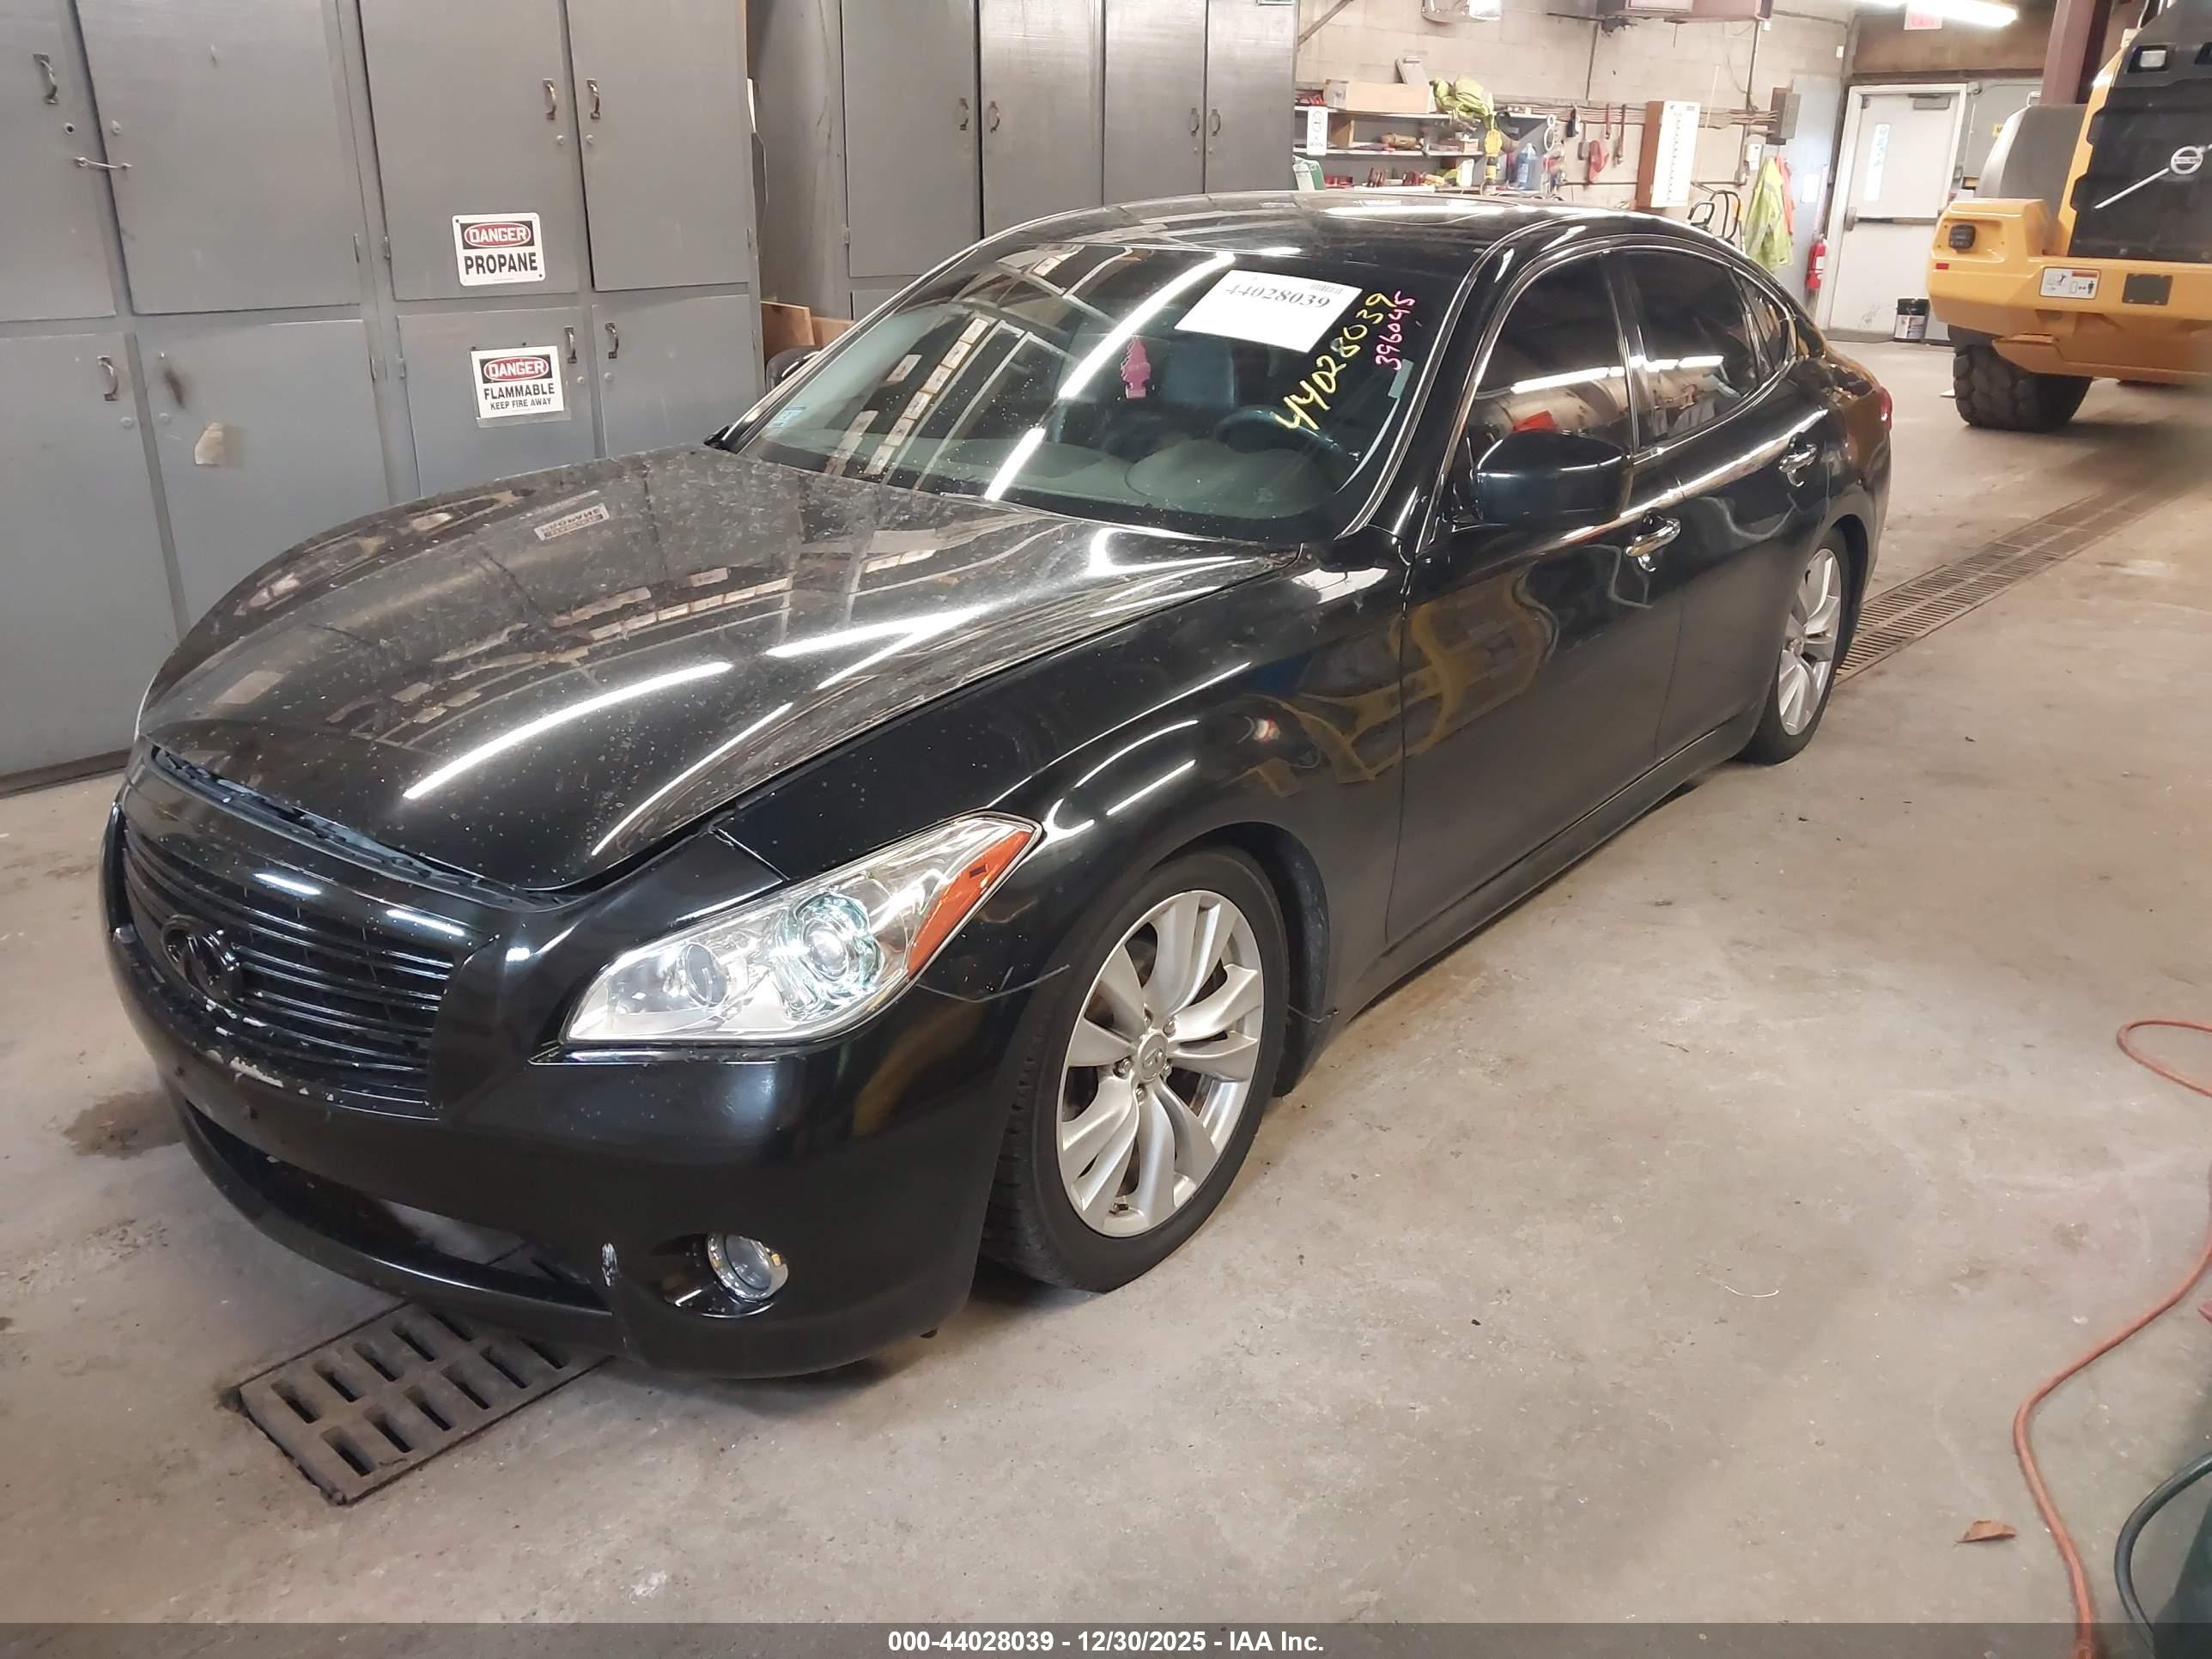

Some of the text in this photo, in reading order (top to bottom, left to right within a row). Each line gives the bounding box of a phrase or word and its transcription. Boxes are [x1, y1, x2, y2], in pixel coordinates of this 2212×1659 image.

[469, 227, 528, 243] DANGER
[464, 252, 538, 276] PROPANE
[1224, 283, 1331, 309] 44028039
[1376, 290, 1415, 371] 396045
[488, 360, 545, 379] DANGER
[1272, 293, 1396, 430] 44028039
[483, 382, 556, 400] FLAMMABLE
[490, 397, 551, 410] KEEP FIRE AWAY
